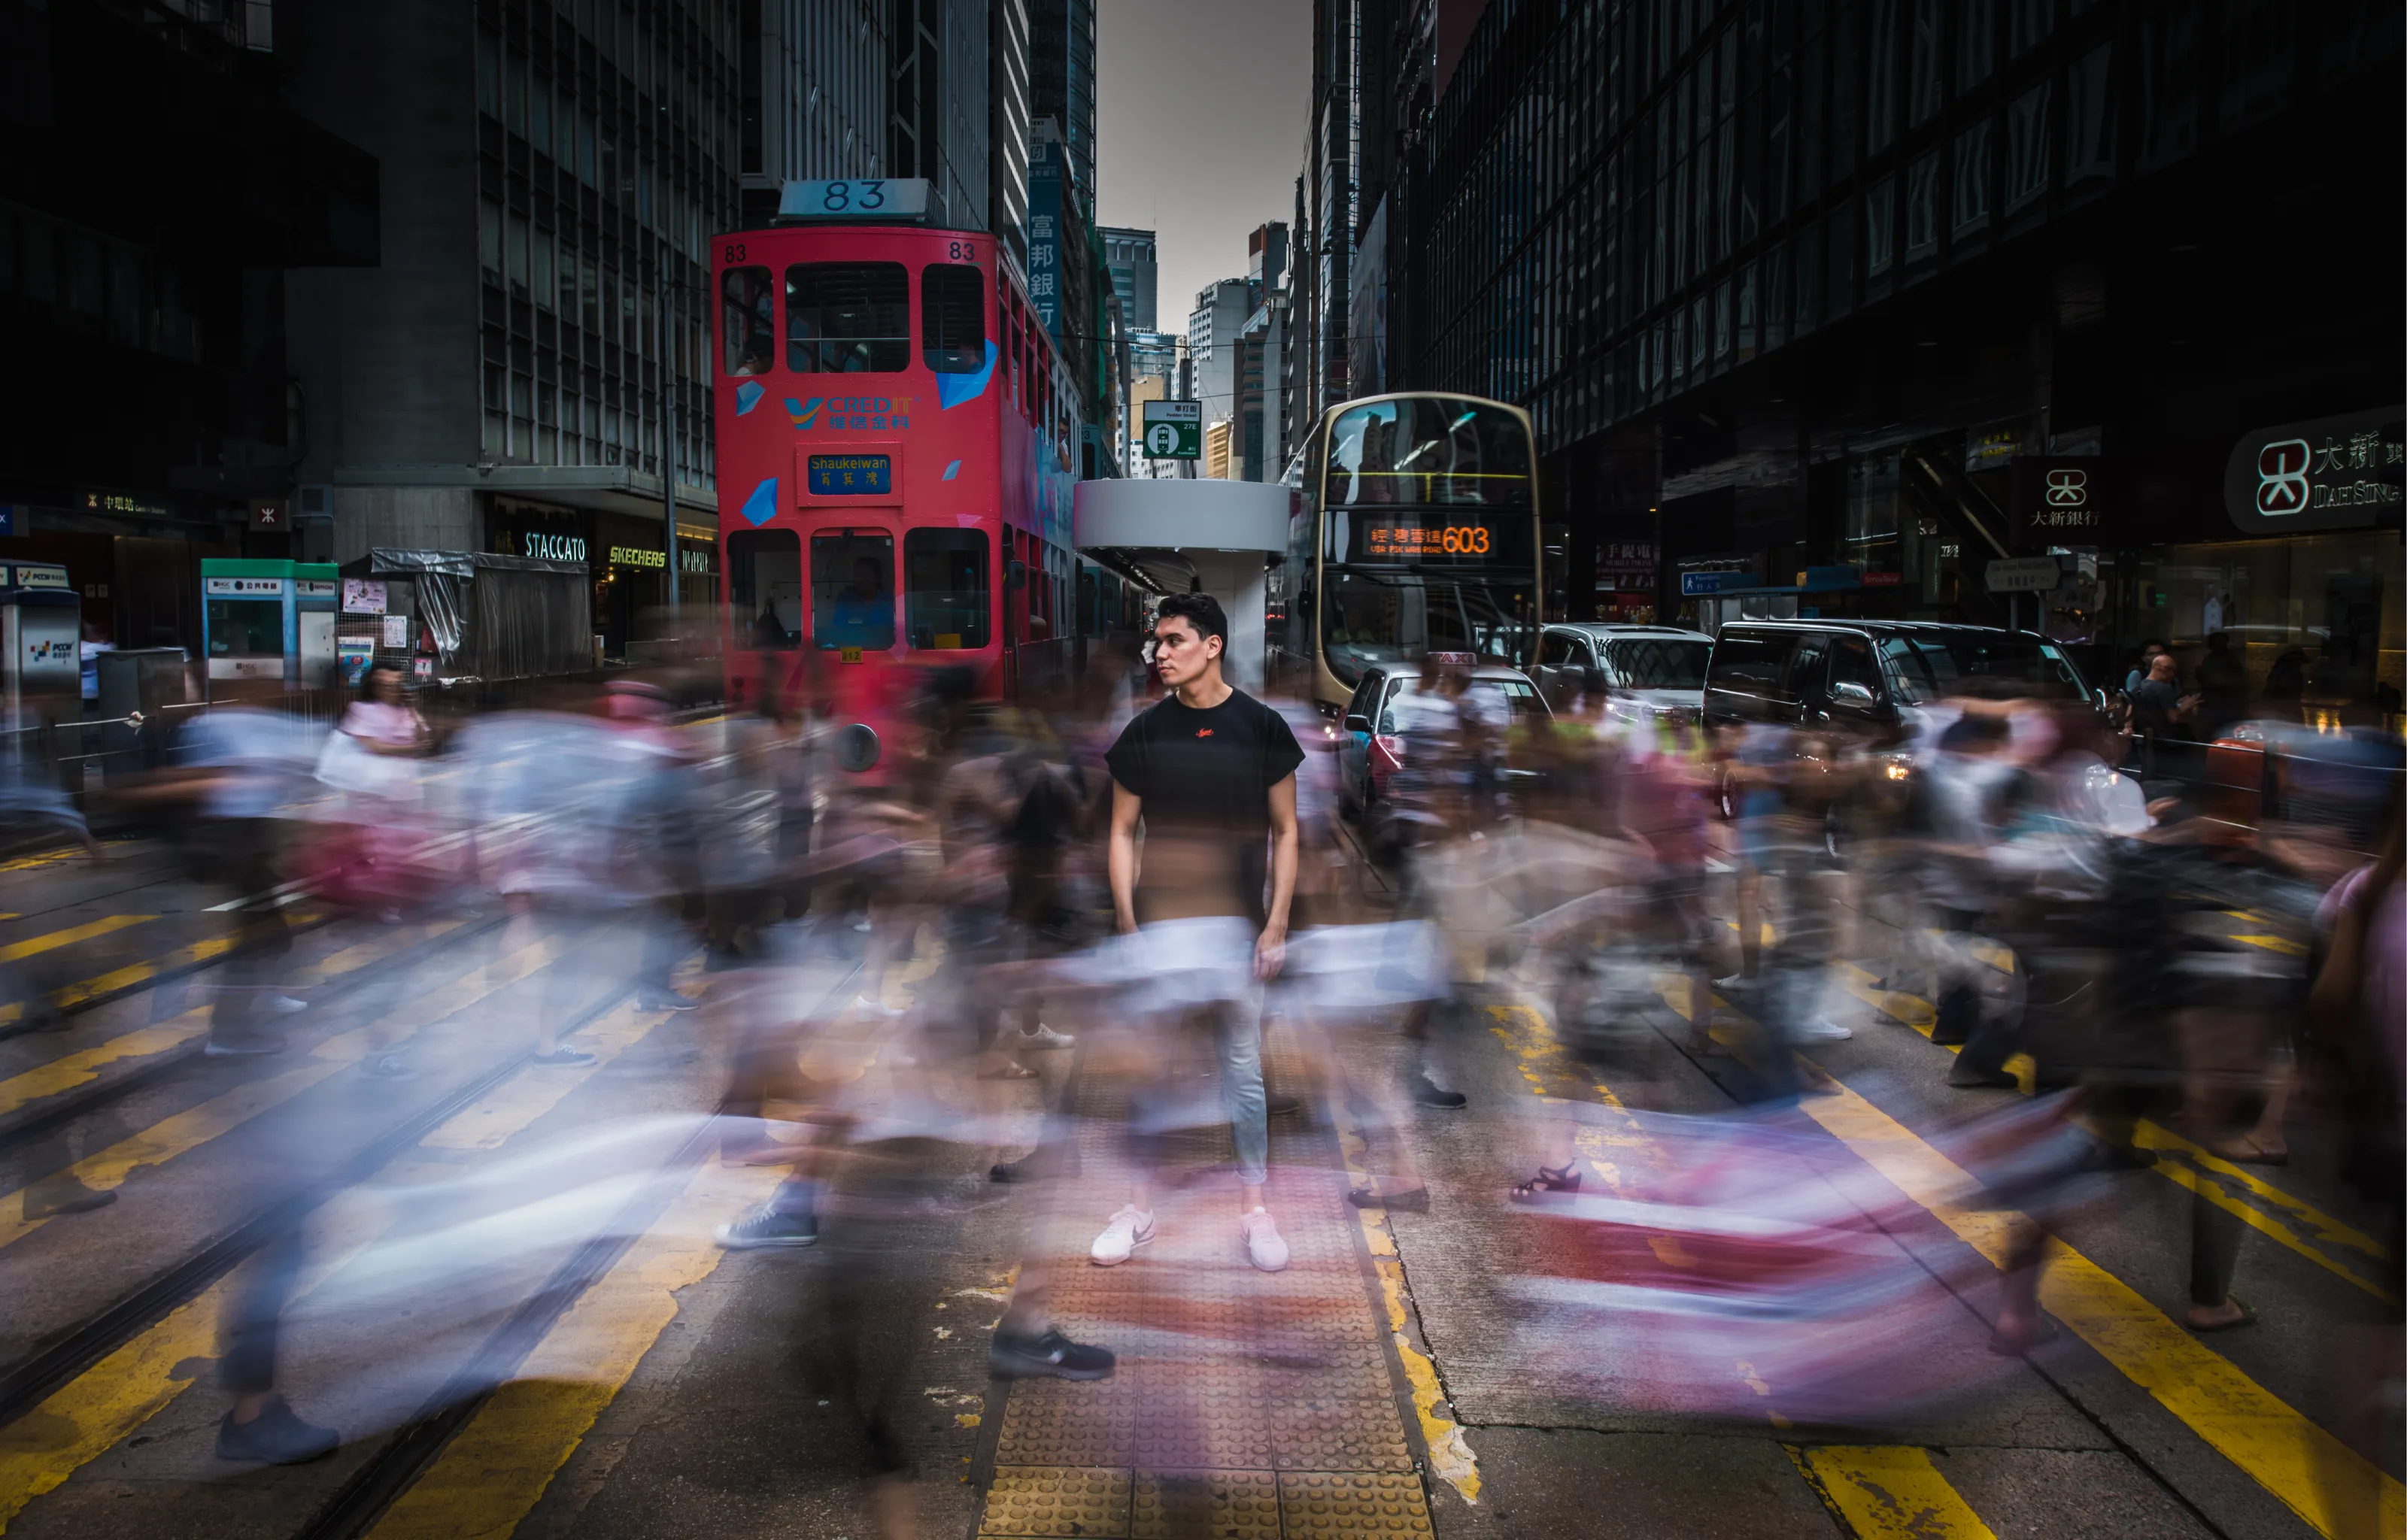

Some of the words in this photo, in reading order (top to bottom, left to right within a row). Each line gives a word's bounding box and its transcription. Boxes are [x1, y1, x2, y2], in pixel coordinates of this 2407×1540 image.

[824, 181, 885, 211] 83
[725, 244, 746, 263] 83
[949, 242, 975, 261] 83
[827, 397, 912, 414] CREDIT
[829, 415, 909, 430] 维信金科
[811, 456, 888, 470] Shaukeiwan
[104, 495, 135, 512] 中環站
[2030, 511, 2102, 527] 大新銀行
[526, 531, 586, 561] STACCATO
[1442, 526, 1490, 553] 603
[609, 545, 666, 568] SKECHERS
[53, 643, 72, 651] PCCW
[1431, 653, 1473, 662] TAXI
